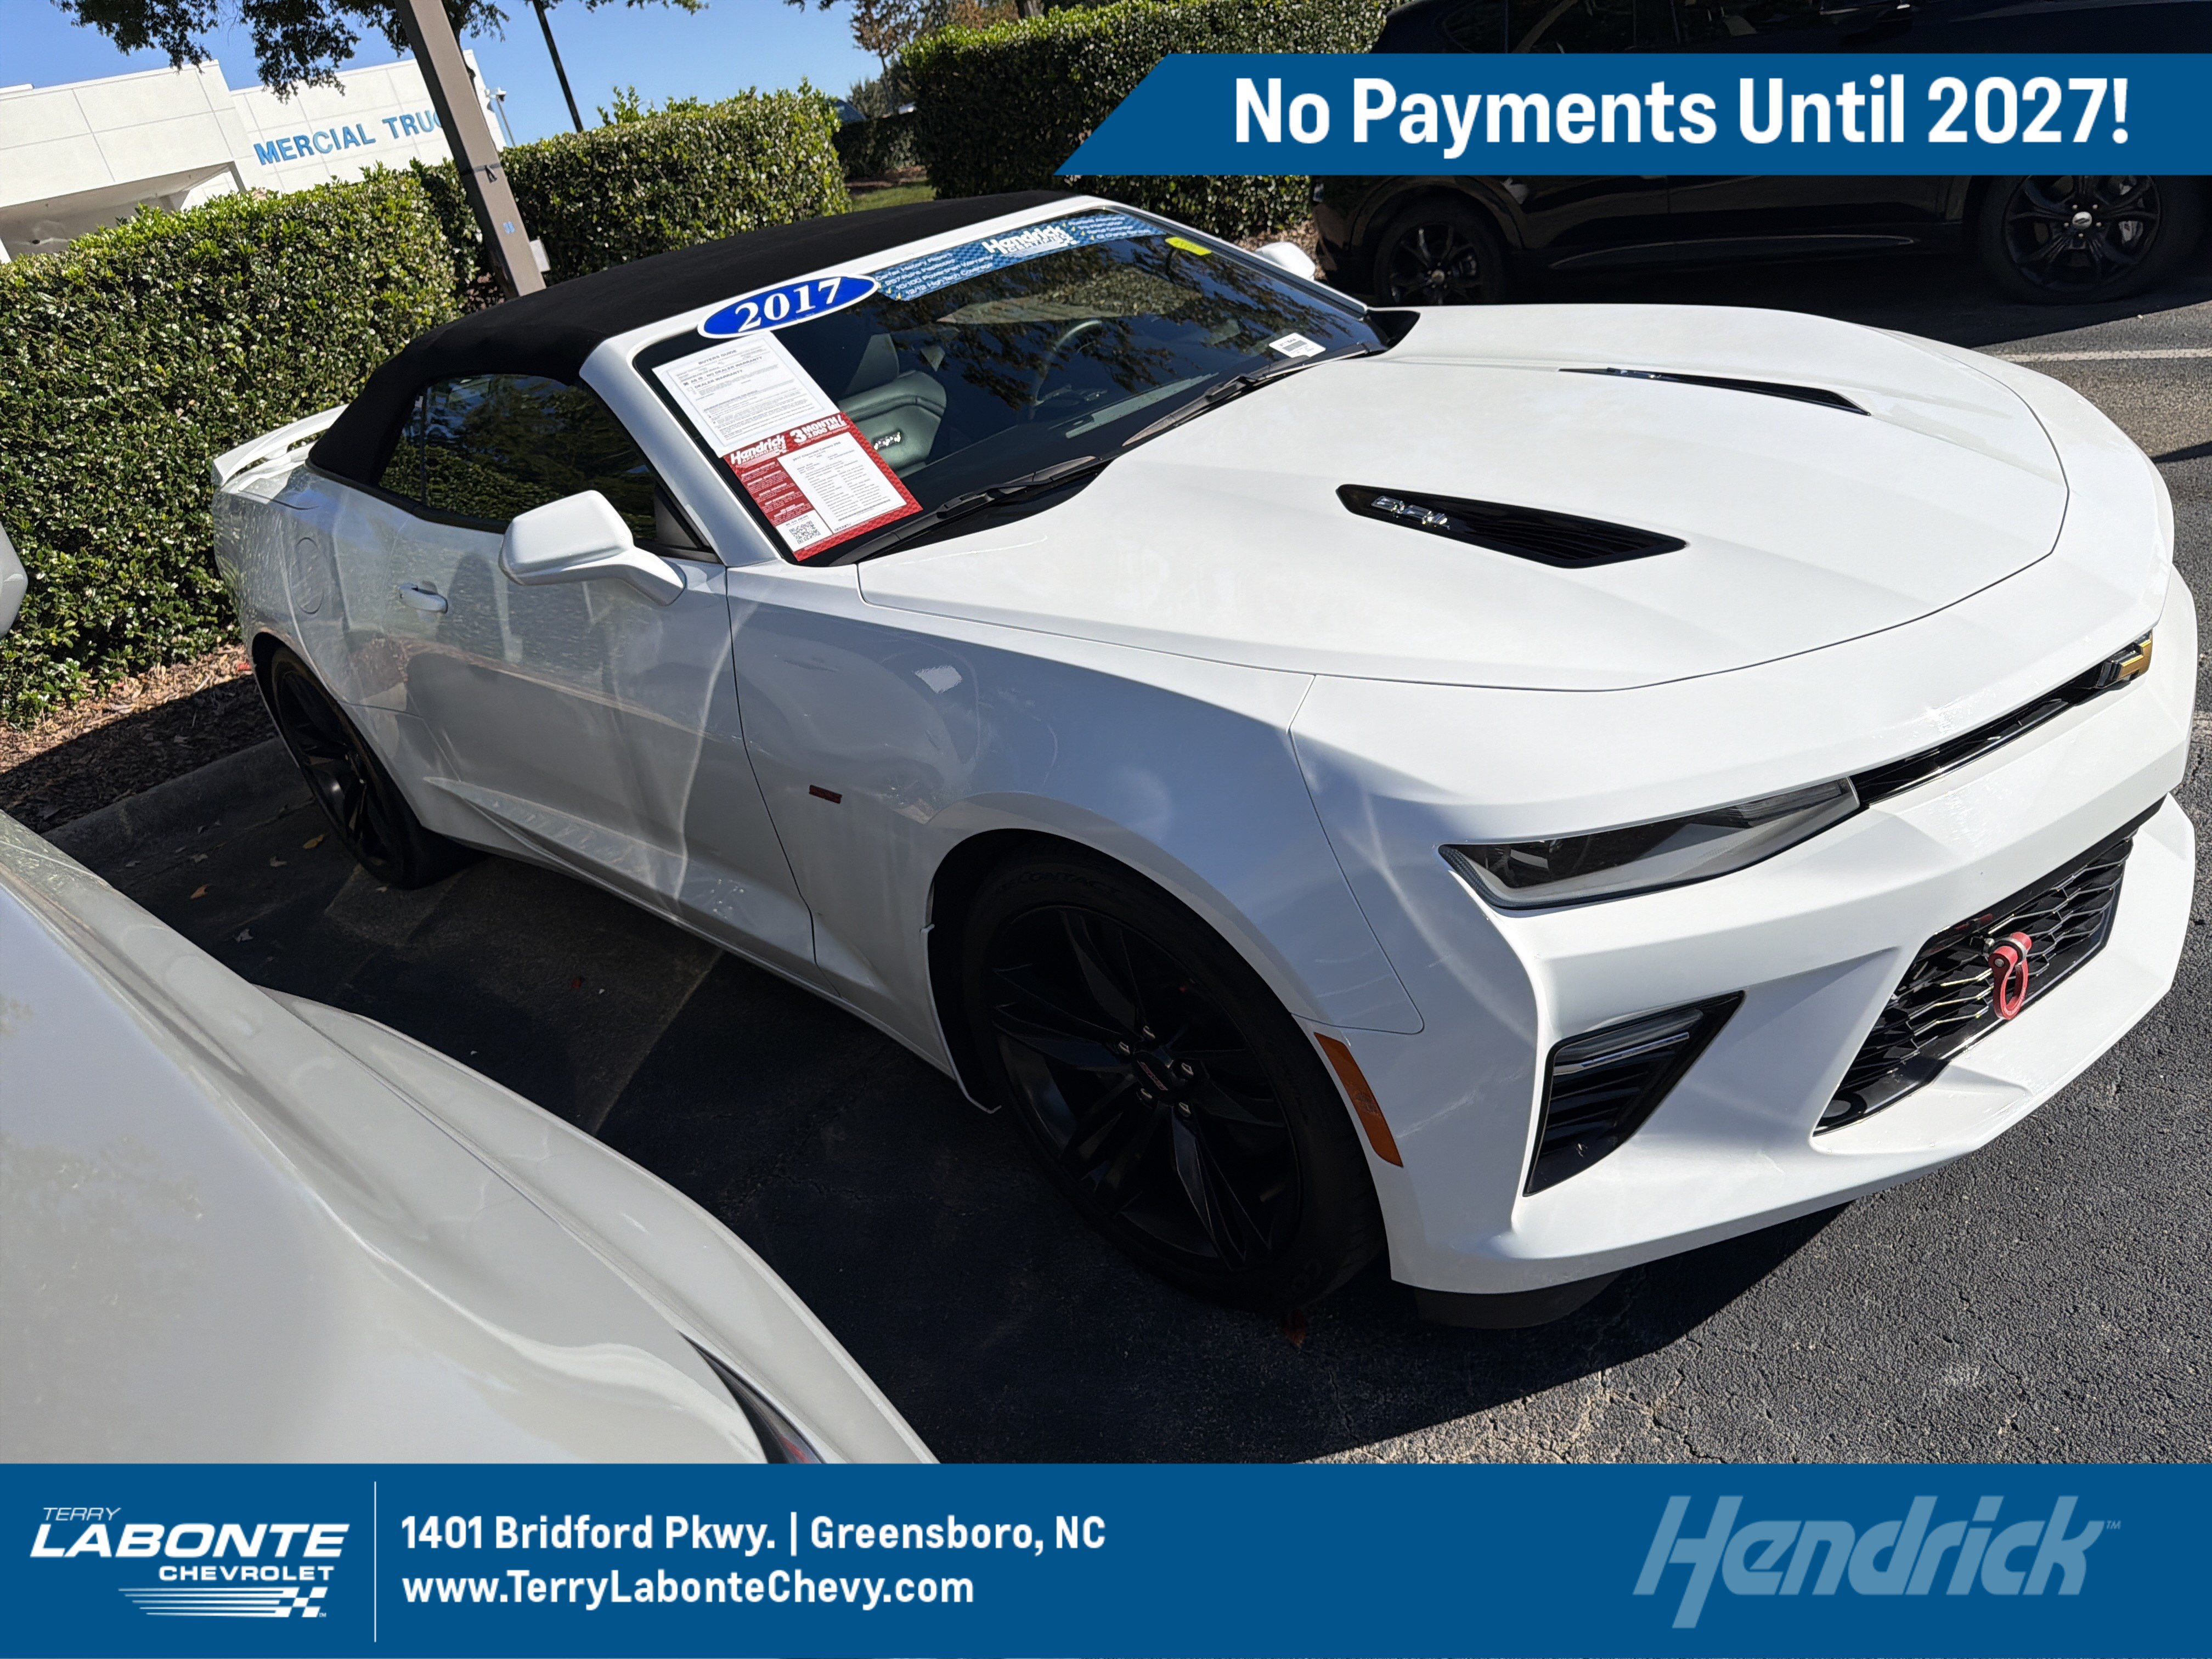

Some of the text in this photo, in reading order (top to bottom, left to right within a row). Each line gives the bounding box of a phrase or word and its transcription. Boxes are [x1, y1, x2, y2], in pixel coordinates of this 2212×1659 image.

[253, 123, 376, 165] MERCIAL
[981, 225, 1068, 255] Hendrick
[895, 277, 922, 291] 10/100
[735, 276, 842, 333] 2017
[730, 435, 786, 465] Hendrick
[789, 429, 807, 443] 3
